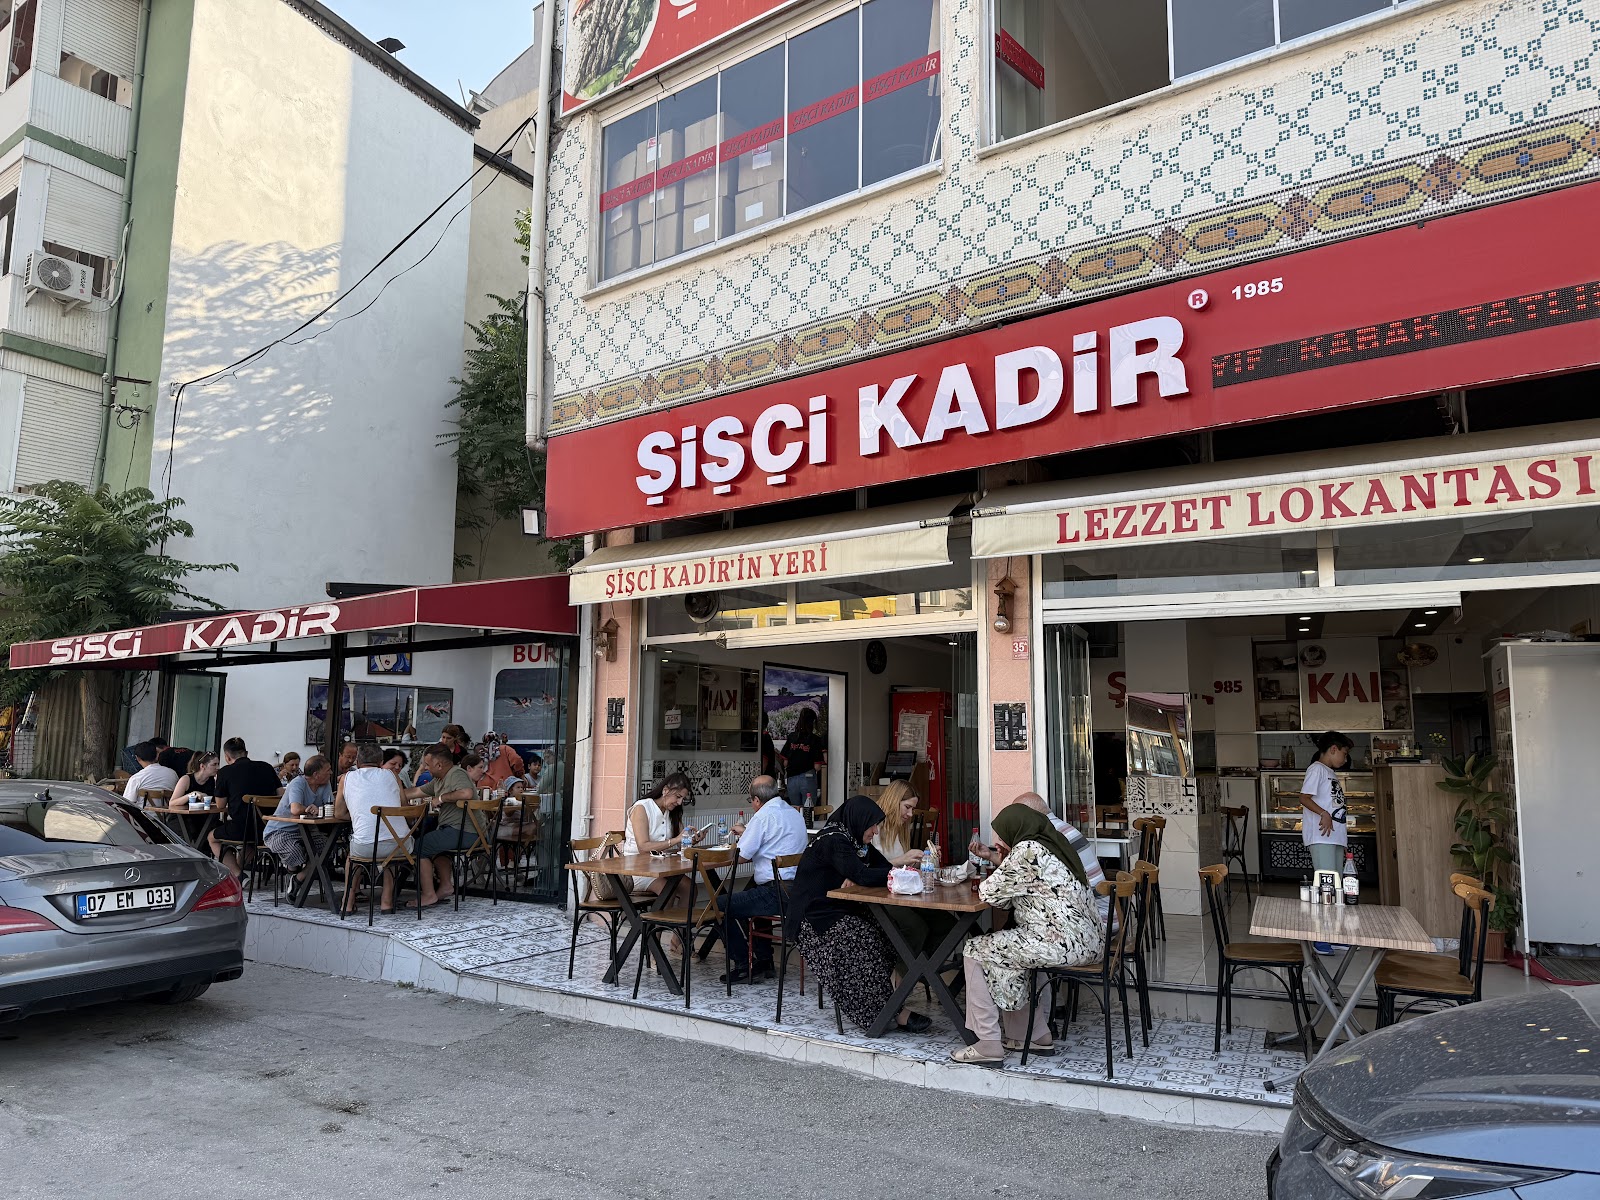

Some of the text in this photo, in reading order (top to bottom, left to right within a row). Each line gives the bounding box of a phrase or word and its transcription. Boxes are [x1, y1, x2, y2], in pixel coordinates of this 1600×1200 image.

[1231, 277, 1284, 300] 1985
[1300, 313, 1441, 361] KABAK
[1055, 455, 1597, 544] LEZZET LOKANTASI
[662, 553, 763, 589] KADİR'İN
[768, 542, 828, 576] YERİ
[88, 888, 172, 911] 07 EM 033
